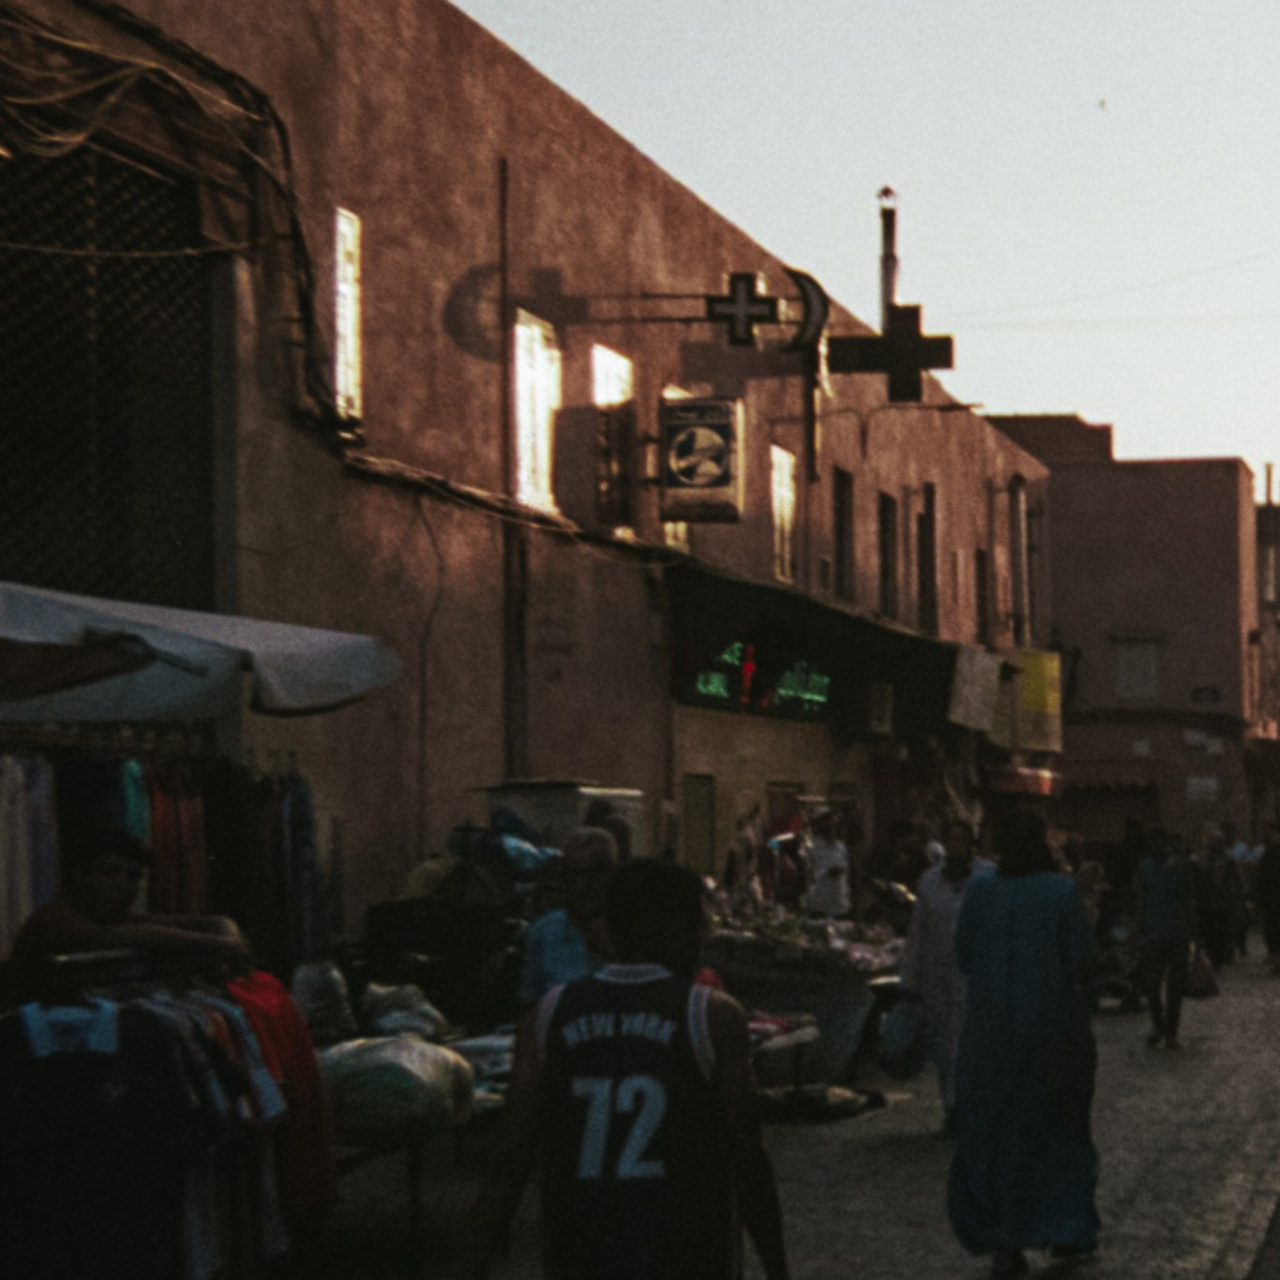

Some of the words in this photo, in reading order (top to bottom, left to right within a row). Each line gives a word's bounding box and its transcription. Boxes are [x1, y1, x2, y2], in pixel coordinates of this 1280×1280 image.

[562, 1014, 616, 1047] NEW
[621, 1013, 676, 1045] YORK
[572, 1074, 667, 1179] 72
